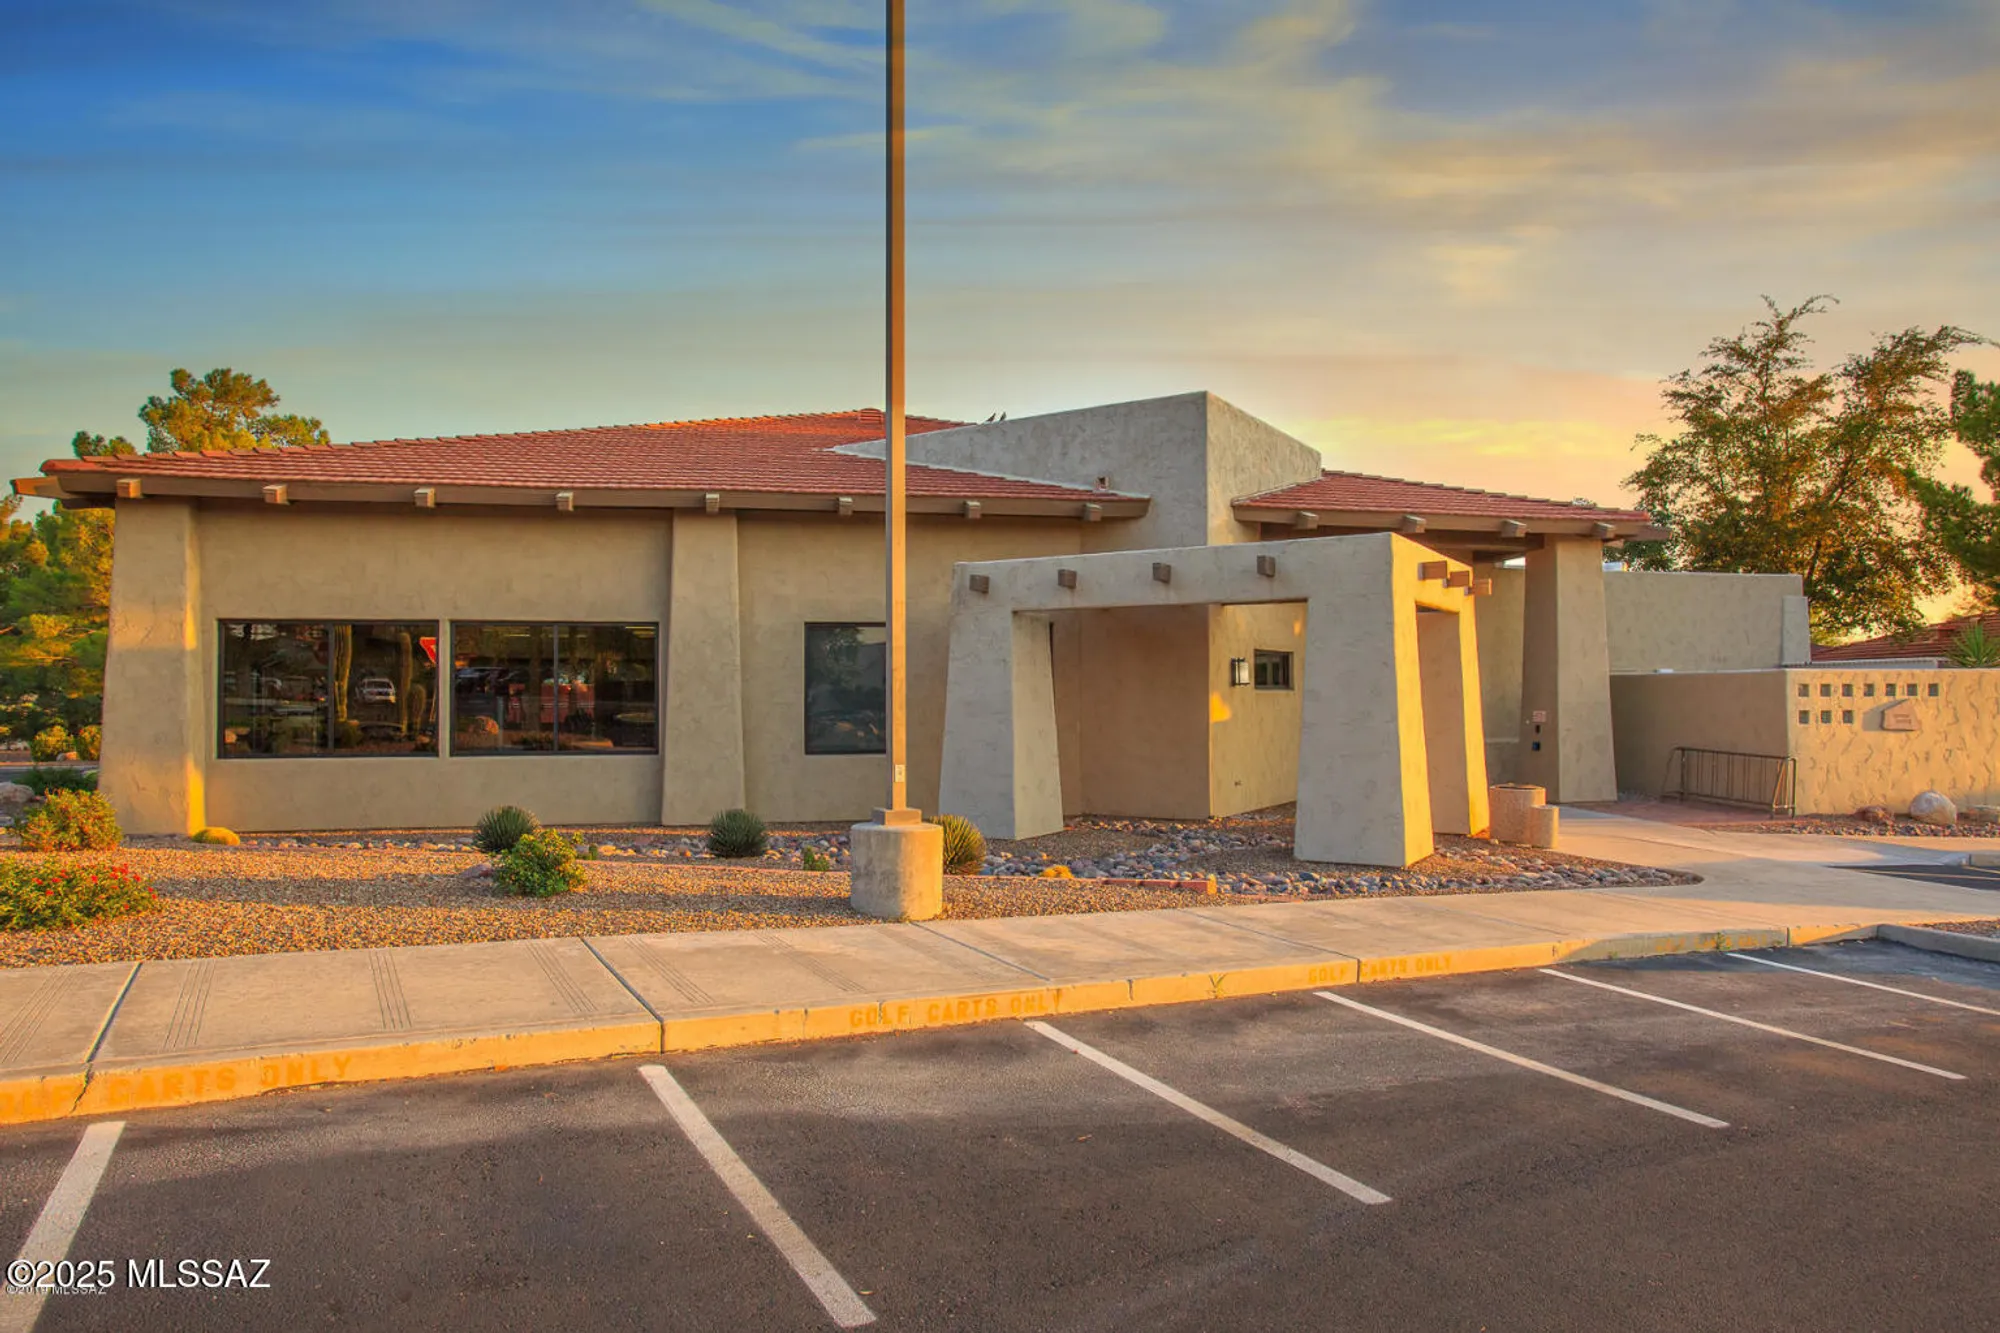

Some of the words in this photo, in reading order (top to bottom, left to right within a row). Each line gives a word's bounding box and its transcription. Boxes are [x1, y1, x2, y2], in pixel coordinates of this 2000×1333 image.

[849, 1005, 909, 1027] GOLF
[928, 998, 998, 1022] CARTS
[1010, 989, 1063, 1013] ONLY
[109, 1068, 237, 1105] CARTS
[261, 1055, 352, 1086] ONLY
